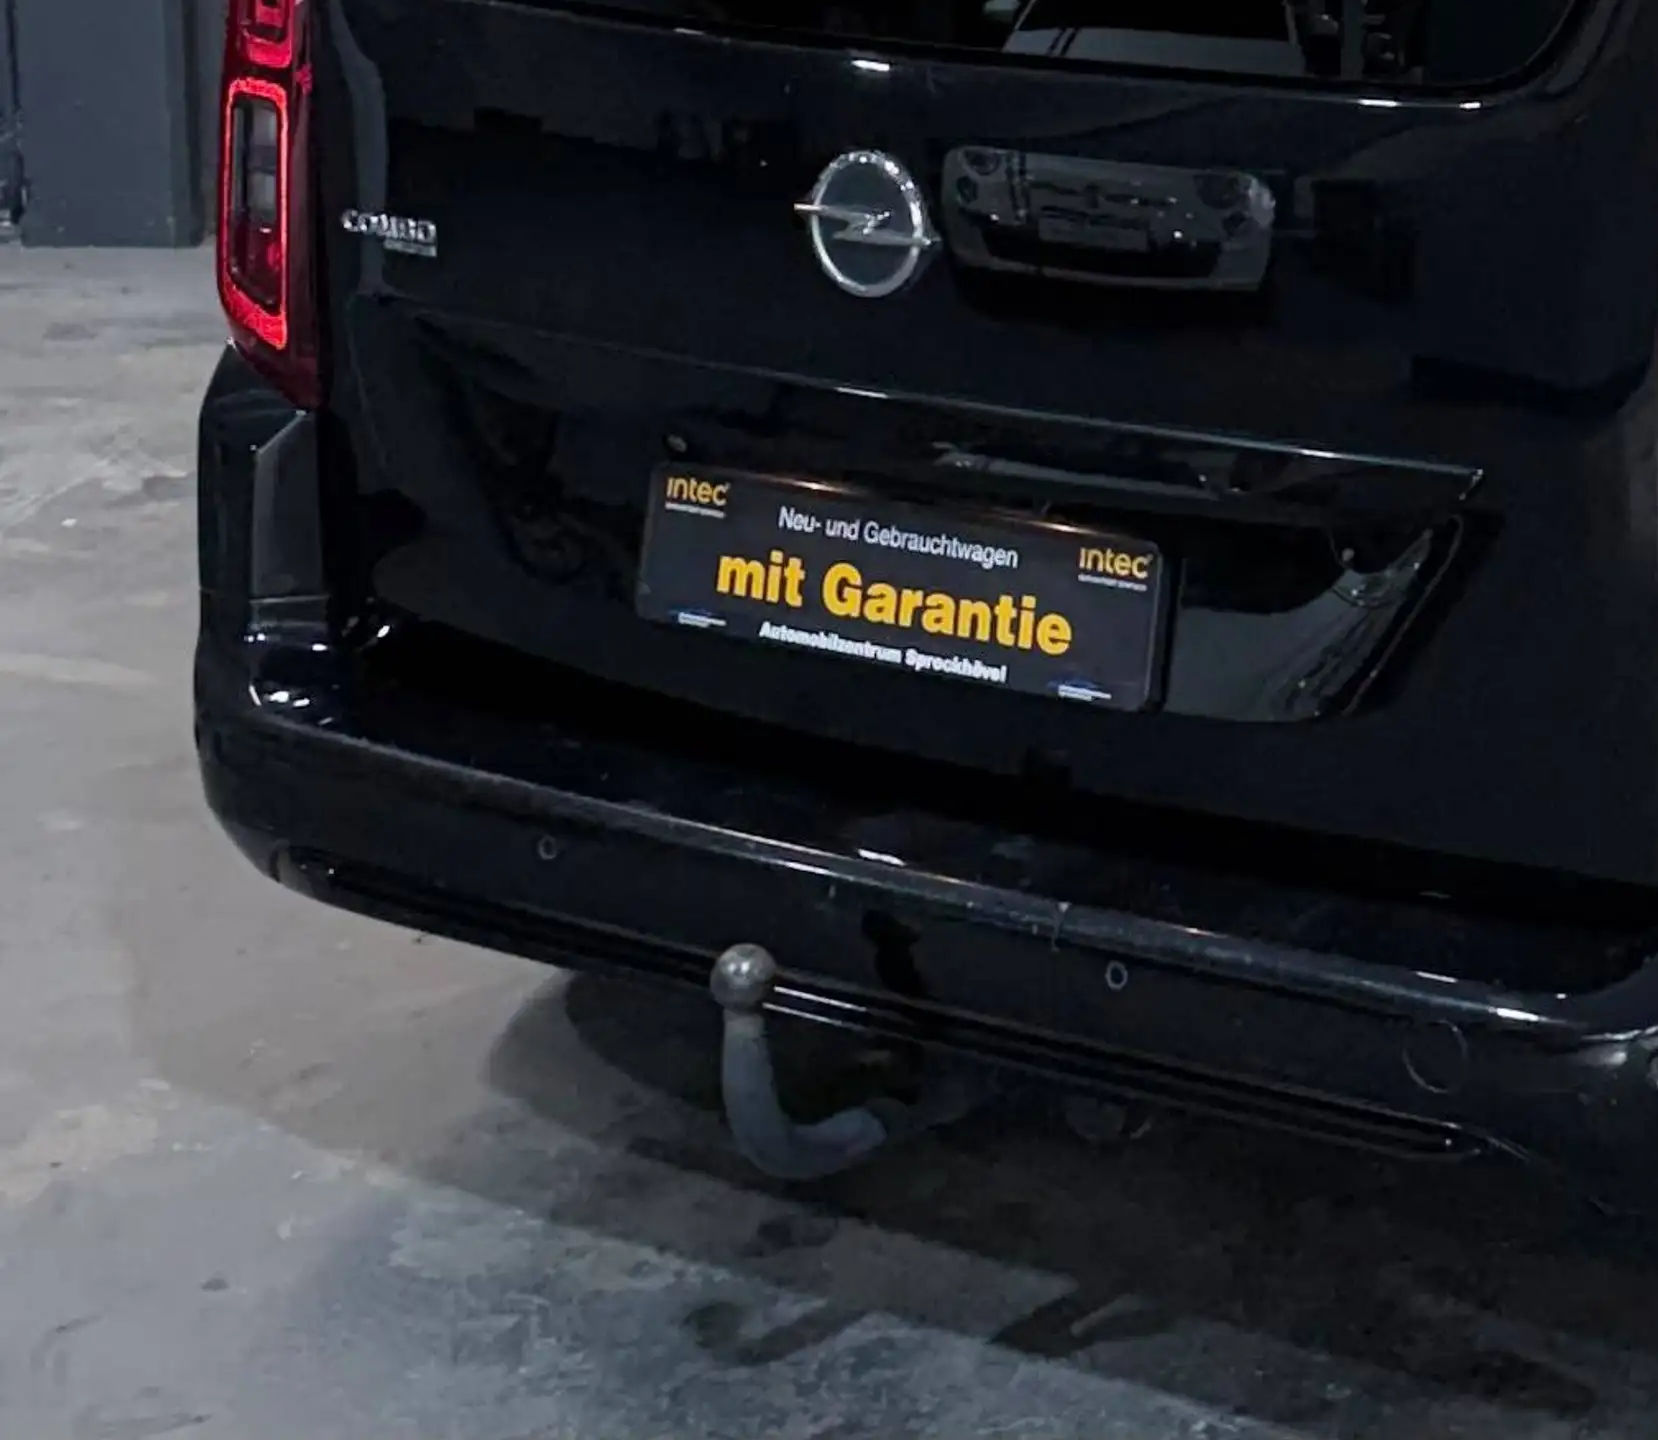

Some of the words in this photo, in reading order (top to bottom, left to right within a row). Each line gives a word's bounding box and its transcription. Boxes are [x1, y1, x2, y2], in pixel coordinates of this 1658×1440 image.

[666, 476, 728, 506] intec
[778, 505, 821, 534] Neu-
[825, 519, 861, 542] und
[863, 520, 1019, 570] Gebrauchtwagen
[1079, 547, 1150, 579] intec
[716, 549, 806, 608] mit
[821, 562, 1073, 656] Garantie
